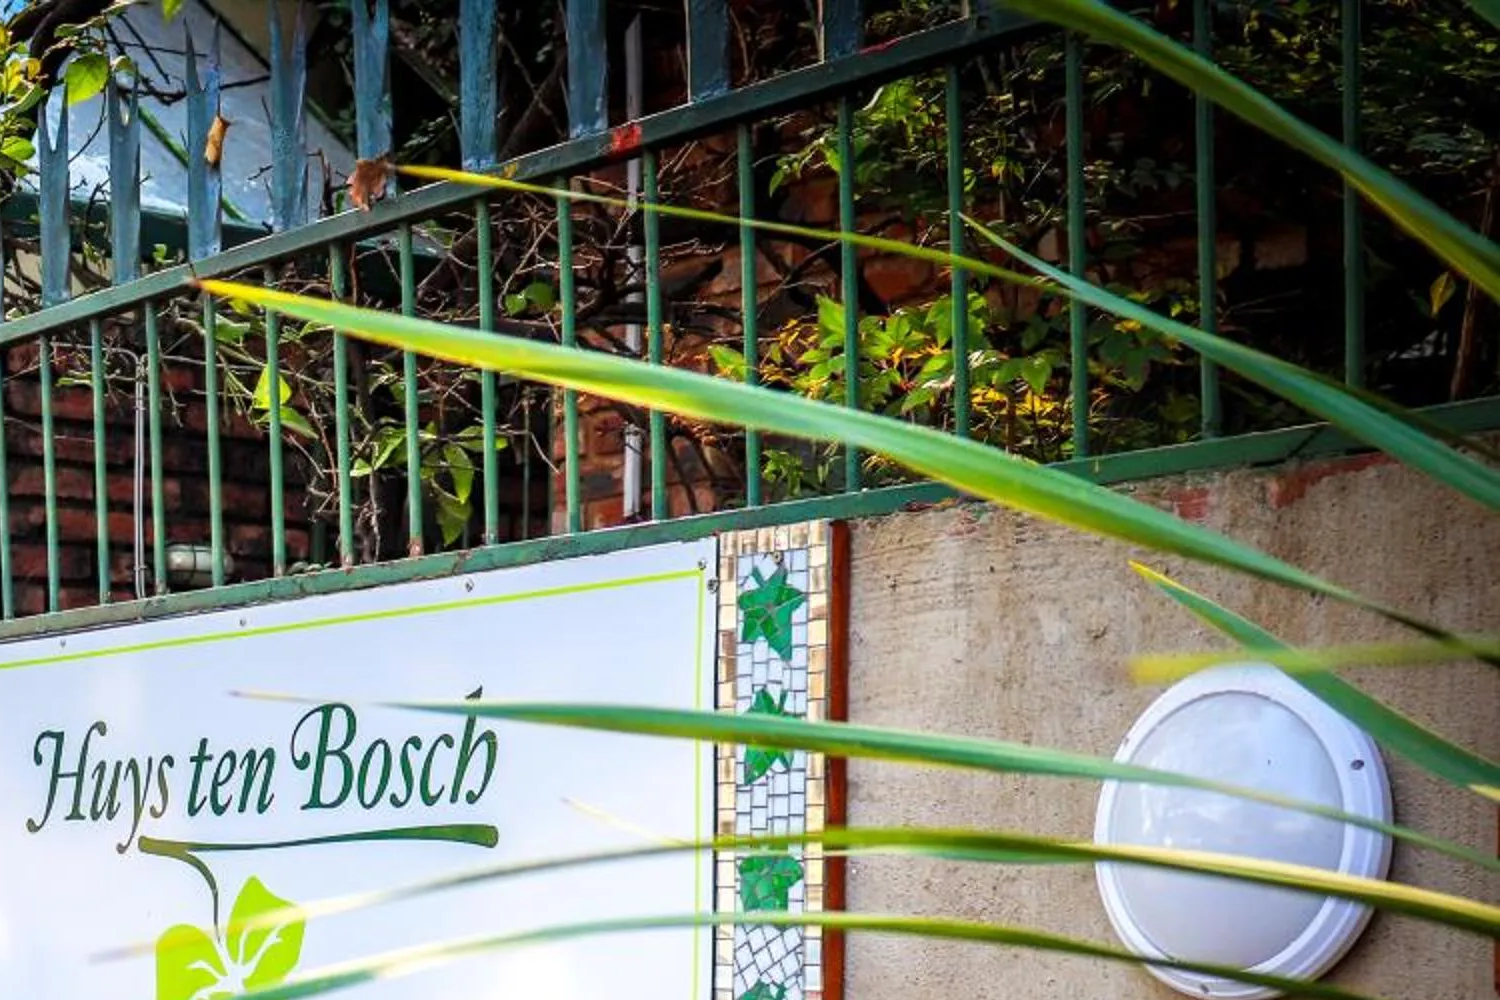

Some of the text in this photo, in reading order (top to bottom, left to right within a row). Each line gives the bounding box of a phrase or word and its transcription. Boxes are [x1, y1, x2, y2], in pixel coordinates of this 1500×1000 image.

[26, 685, 498, 854] Huys ten Bosch
